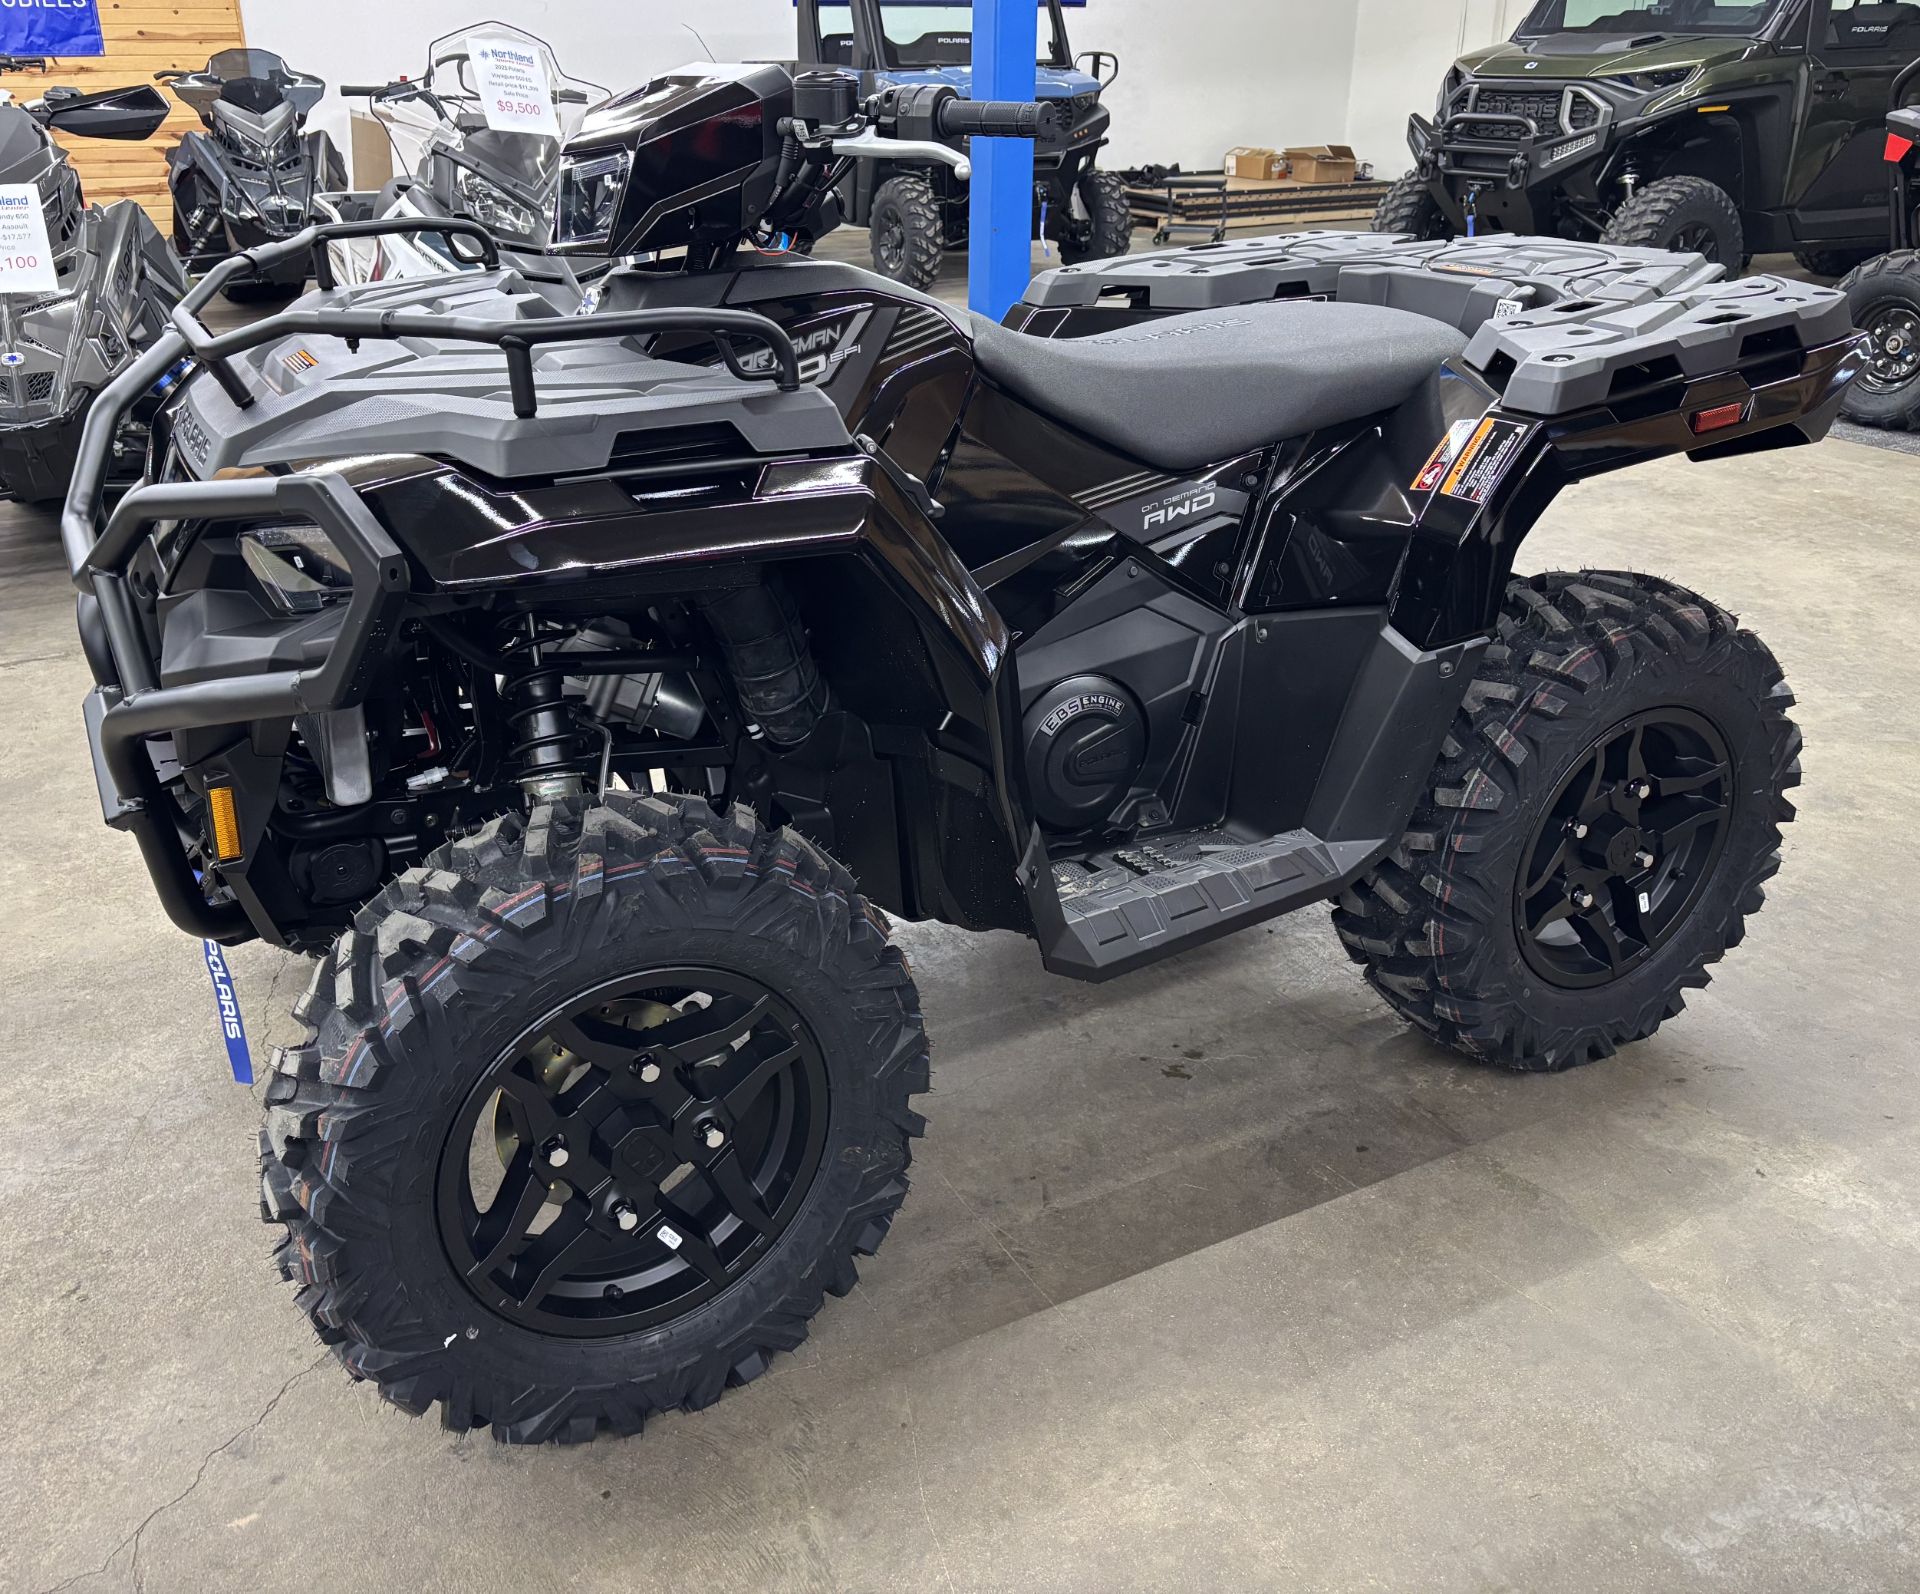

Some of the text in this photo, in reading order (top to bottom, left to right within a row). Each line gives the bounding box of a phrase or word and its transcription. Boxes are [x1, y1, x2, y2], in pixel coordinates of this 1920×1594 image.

[1851, 25, 1888, 33] POLARIS
[490, 48, 534, 64] Northland
[496, 99, 541, 116] $9,500
[1476, 101, 1558, 119] POLARIS
[0, 195, 29, 206] land
[829, 344, 861, 363] EFI
[1459, 435, 1482, 467] WARNING
[1141, 480, 1217, 513] ON DEMAND
[1143, 491, 1216, 530] AWD
[1044, 695, 1122, 732] EBS ENGINE
[205, 938, 242, 1039] POLARIS
